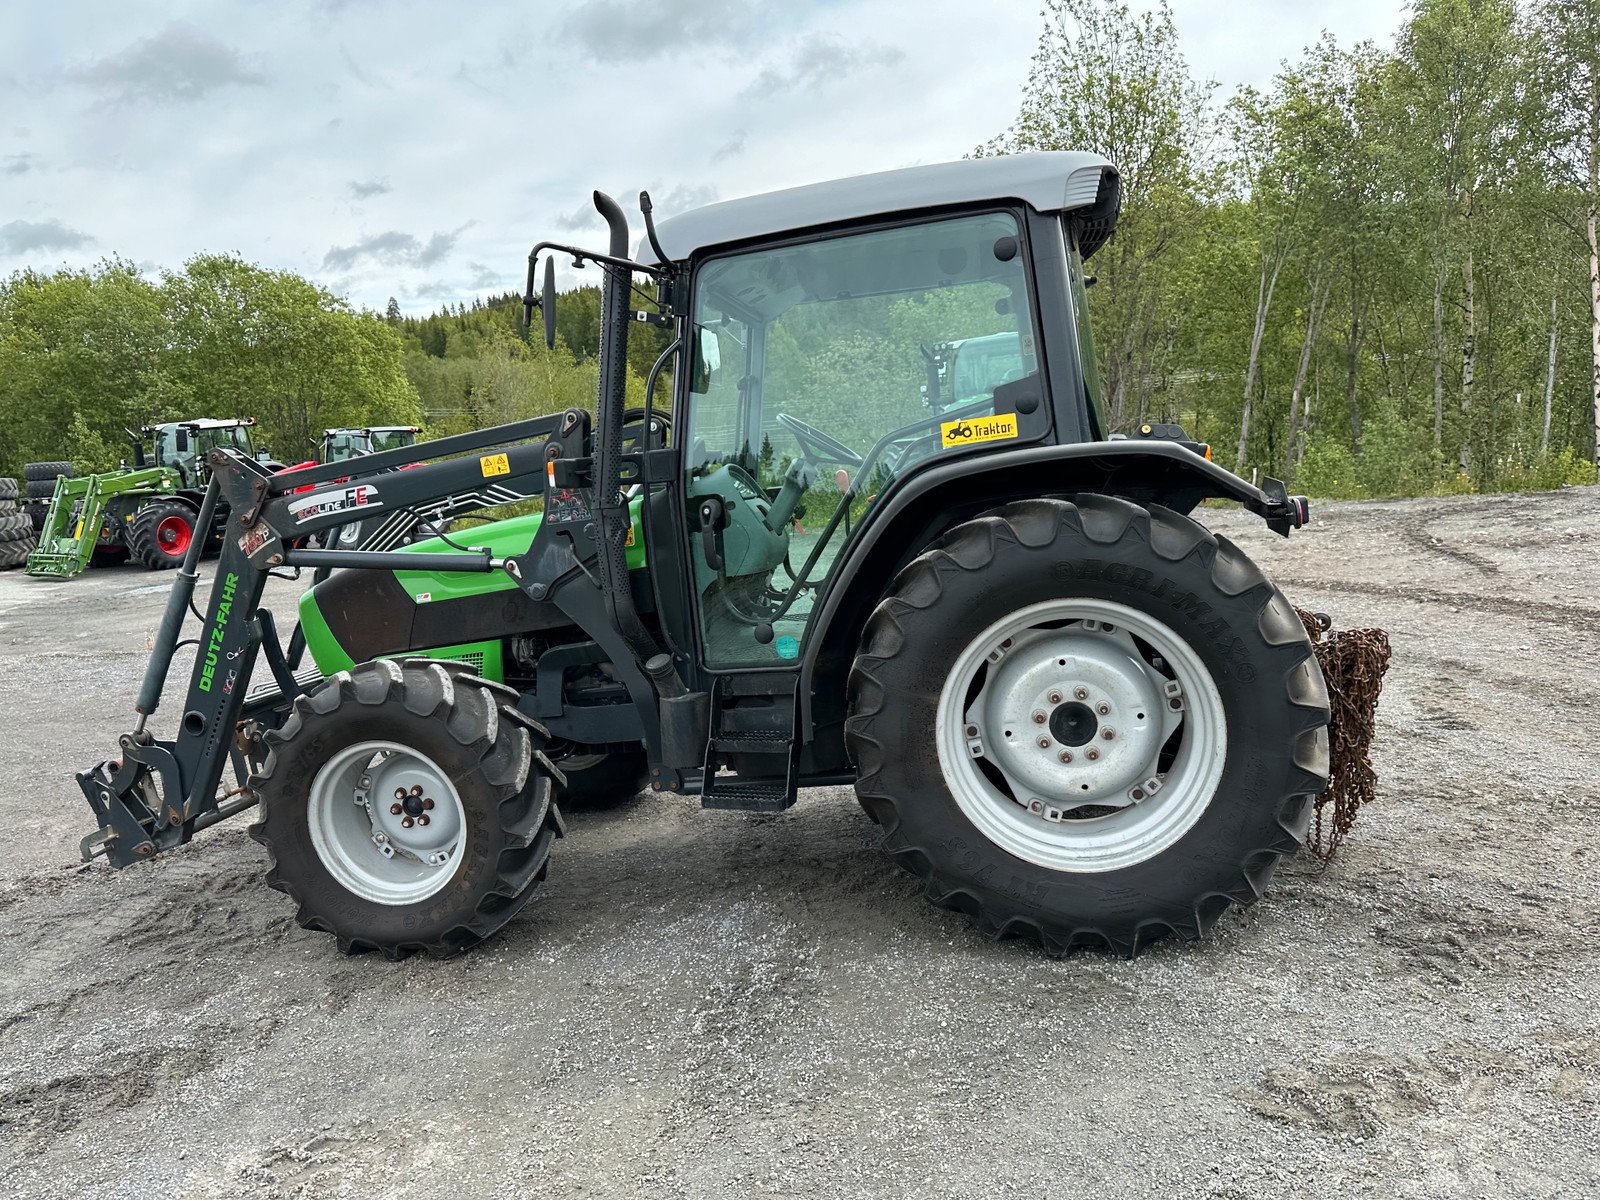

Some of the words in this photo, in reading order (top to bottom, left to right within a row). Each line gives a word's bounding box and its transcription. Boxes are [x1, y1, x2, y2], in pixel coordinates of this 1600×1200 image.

[974, 423, 1011, 437] Traktor
[345, 487, 368, 508] FE
[199, 572, 239, 692] DEUTZ-FAHR
